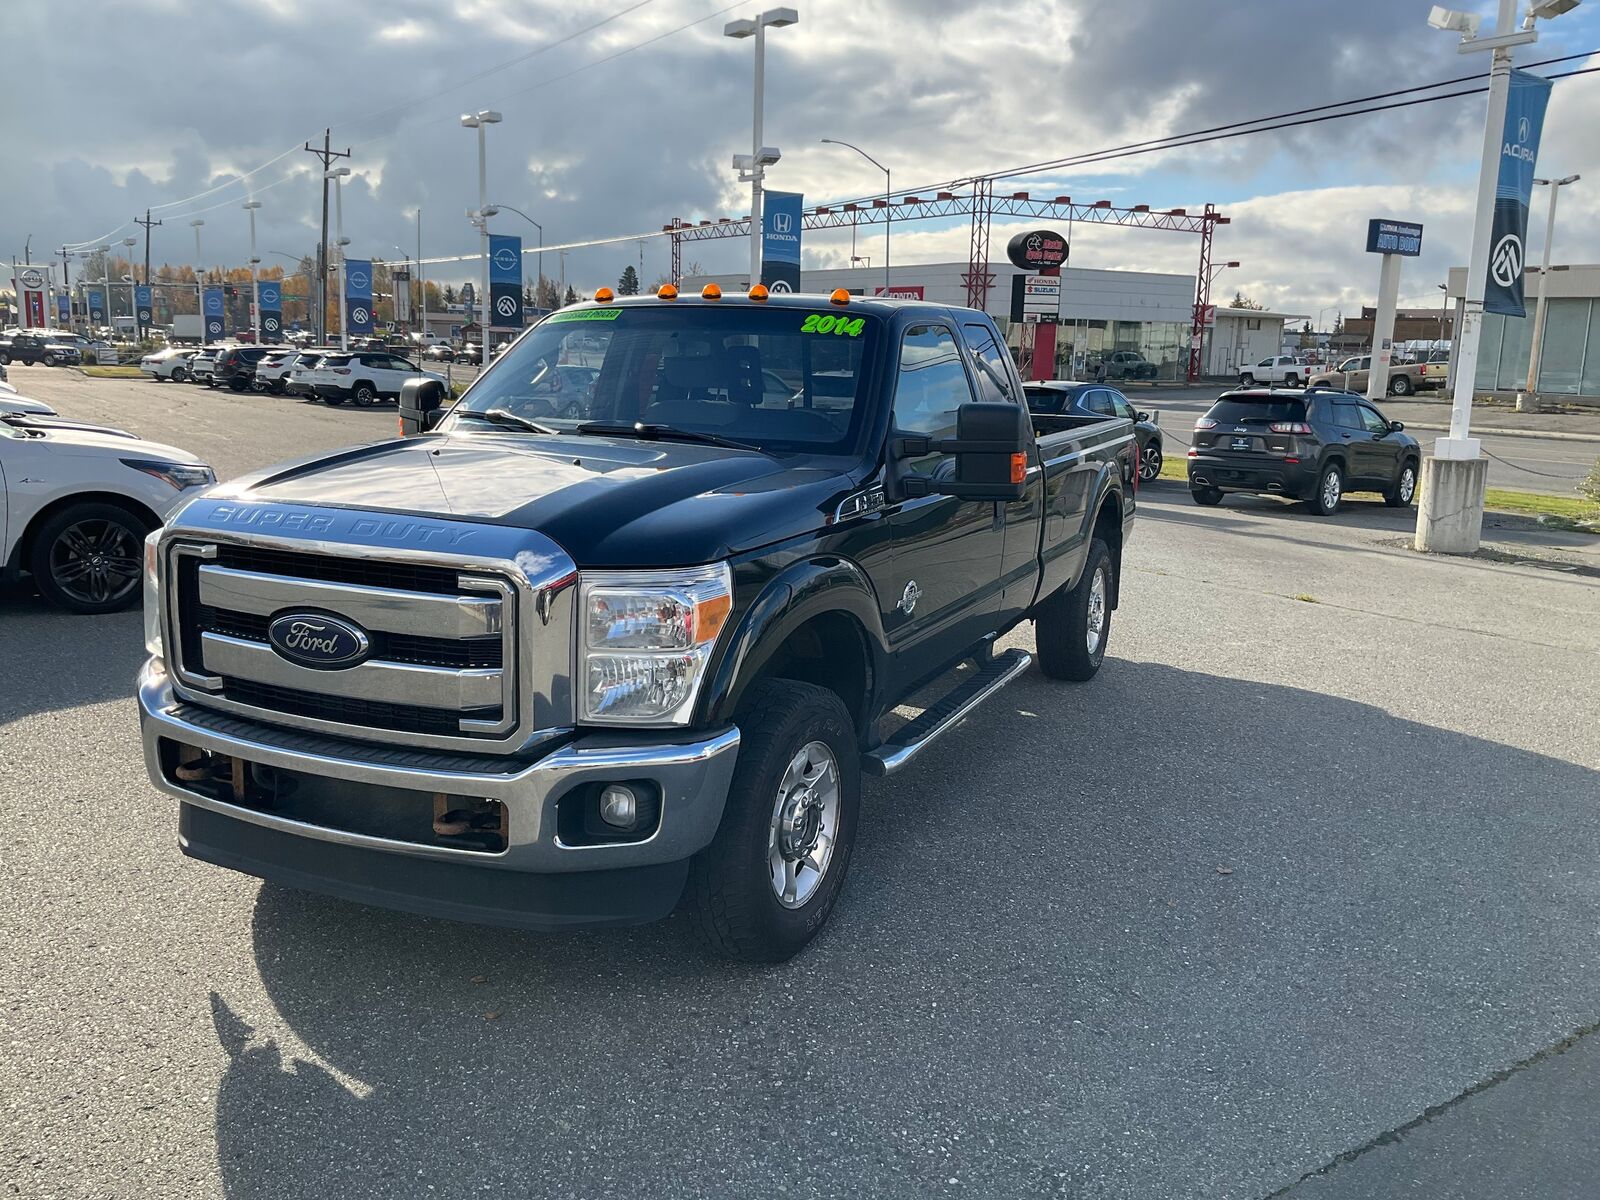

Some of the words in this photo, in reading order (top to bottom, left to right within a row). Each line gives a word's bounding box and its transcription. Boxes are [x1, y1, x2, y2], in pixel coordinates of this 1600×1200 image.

[1503, 143, 1534, 162] ACURA
[766, 233, 798, 242] HONDA
[1377, 234, 1398, 249] AUTO
[1399, 236, 1420, 252] BODY
[801, 314, 865, 337] 2014
[208, 506, 335, 534] SUPER
[348, 518, 479, 545] DUTY
[286, 621, 338, 655] Ford
